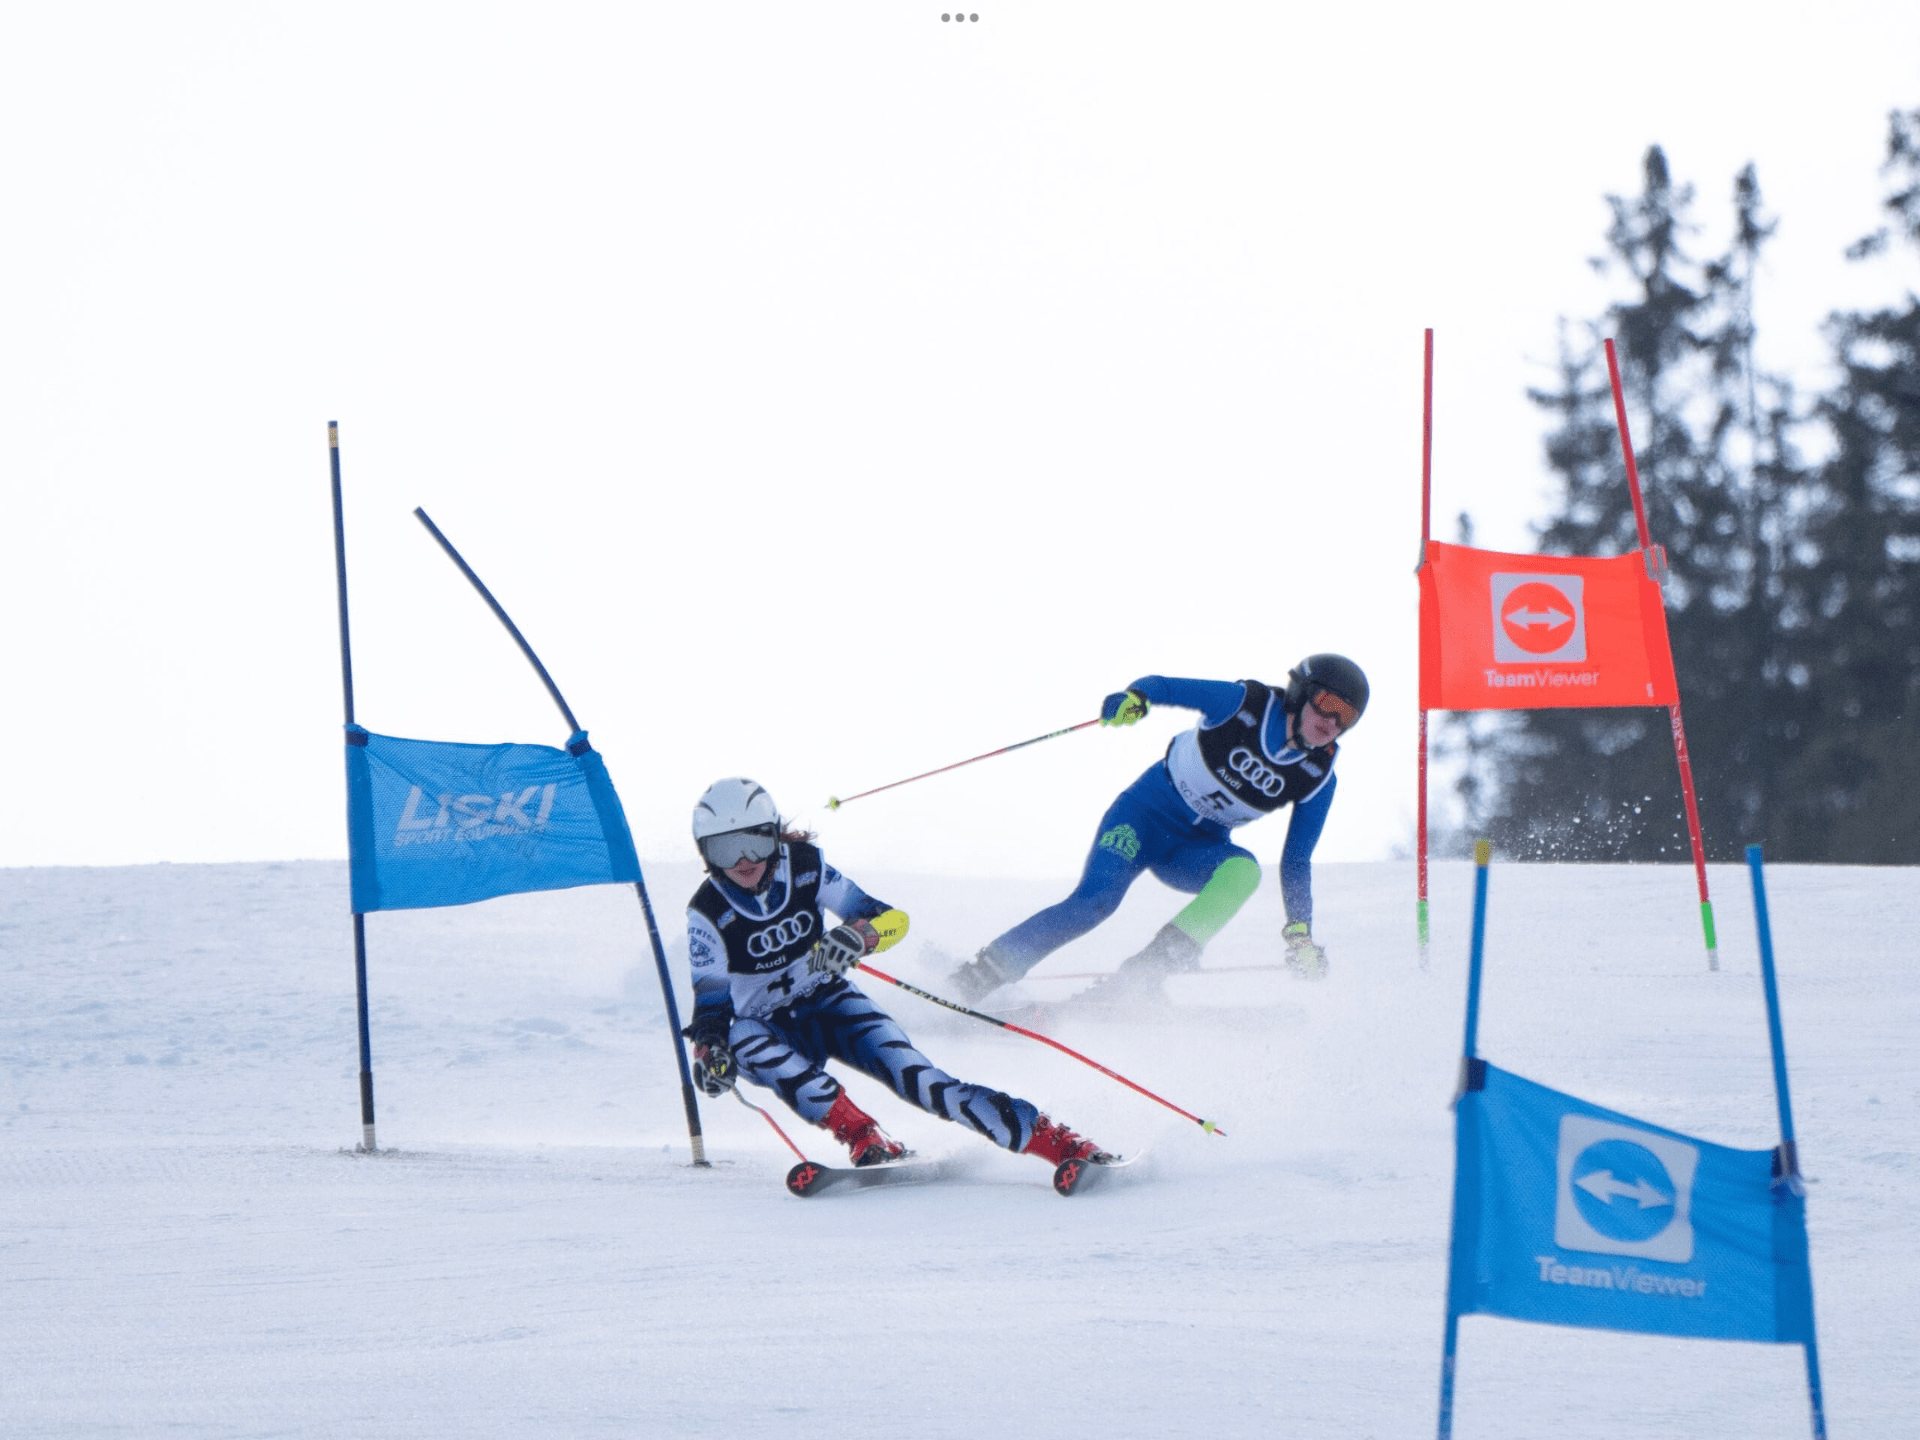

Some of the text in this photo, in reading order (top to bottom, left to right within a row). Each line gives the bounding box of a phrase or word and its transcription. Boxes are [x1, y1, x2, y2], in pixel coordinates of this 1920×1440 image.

[1484, 668, 1600, 688] TeamViewer
[1215, 767, 1243, 790] Audi
[397, 783, 557, 830] LISKI
[755, 954, 787, 971] Audi
[1534, 1255, 1707, 1298] TeamViewer
